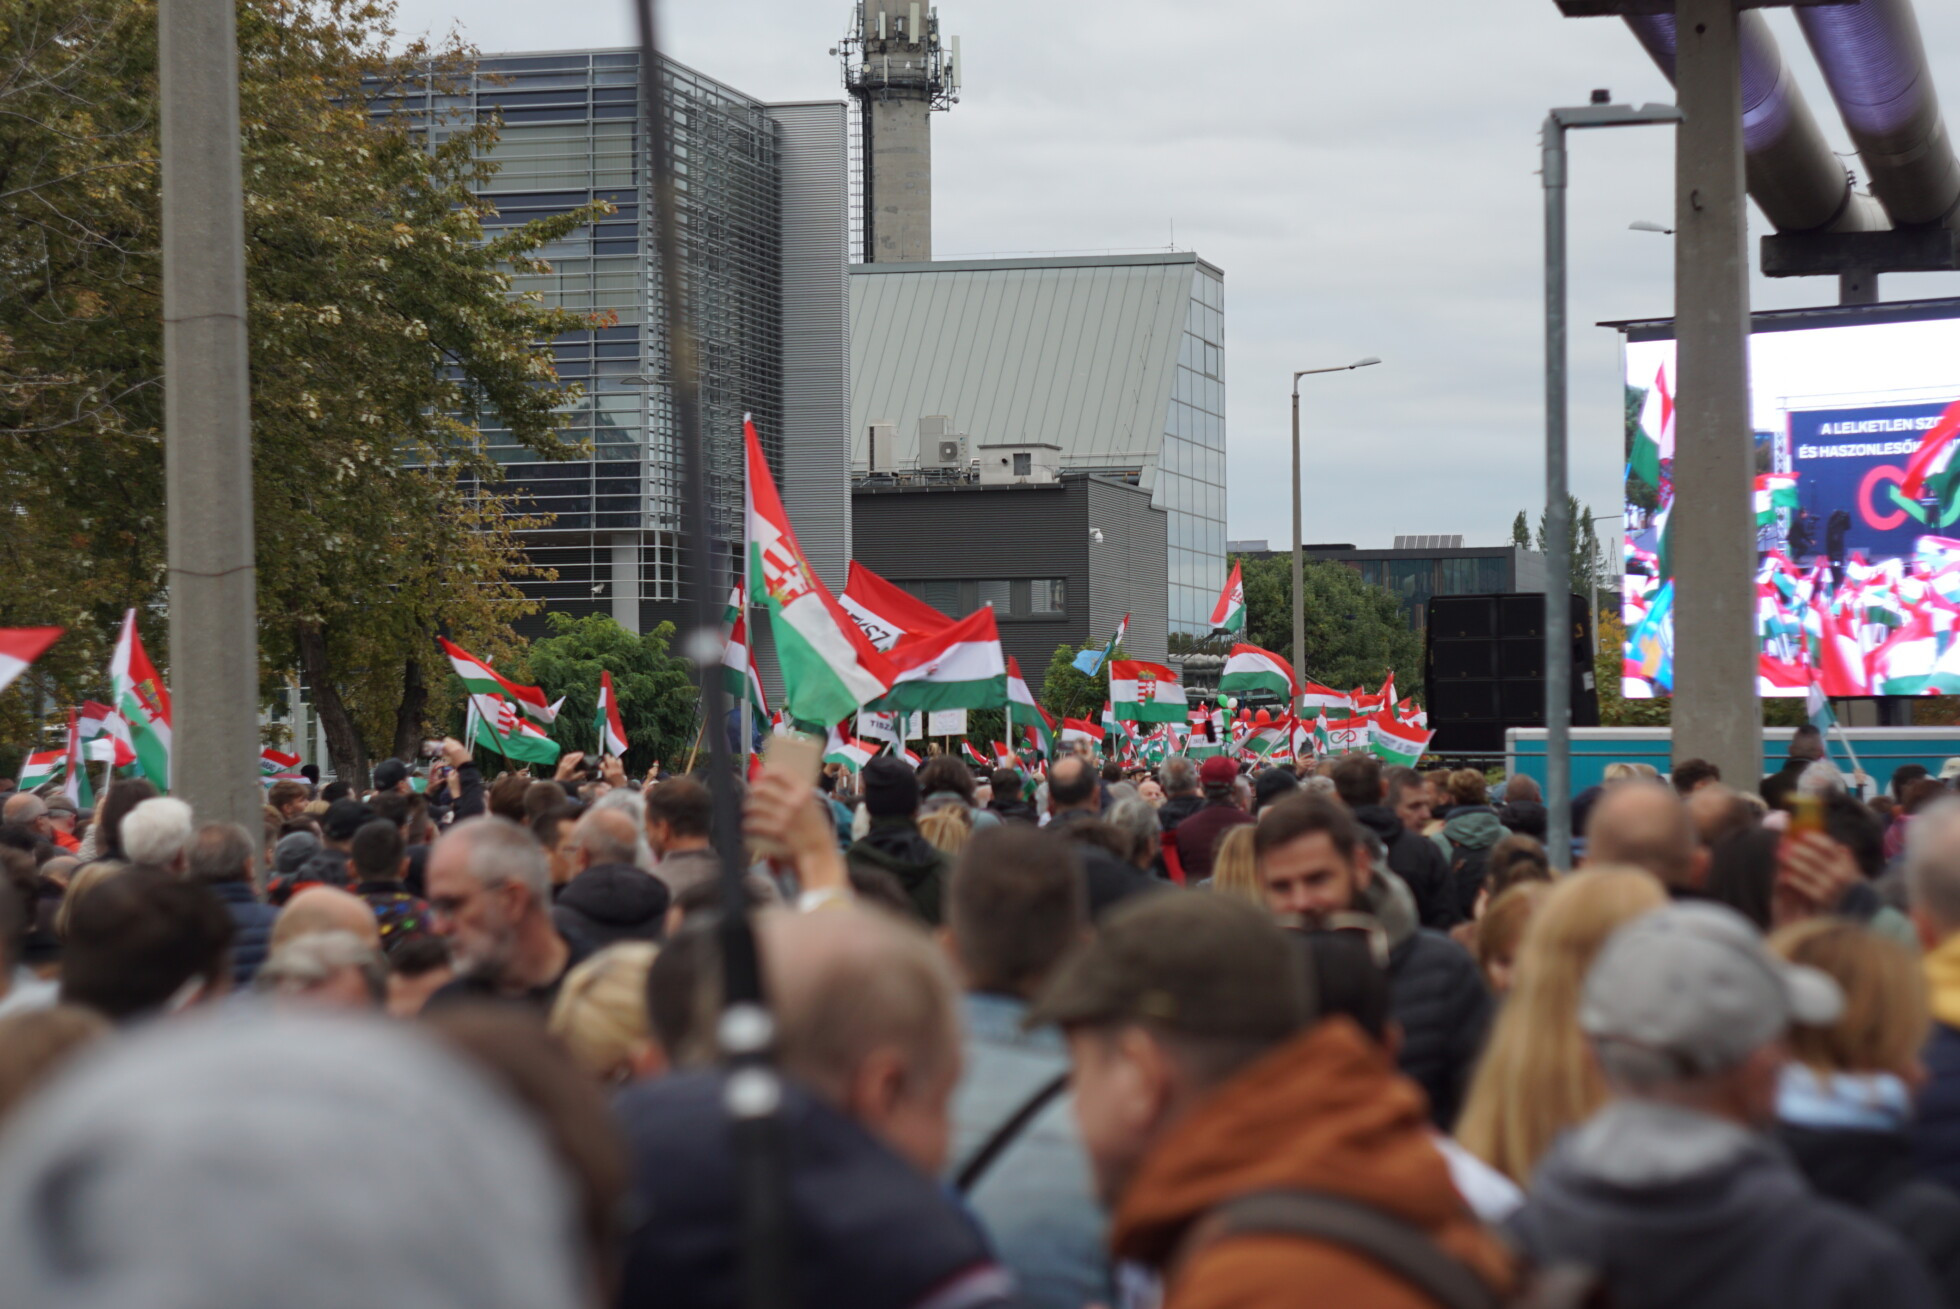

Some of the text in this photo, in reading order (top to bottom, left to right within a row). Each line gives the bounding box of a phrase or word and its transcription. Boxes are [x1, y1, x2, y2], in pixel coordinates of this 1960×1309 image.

[1821, 422, 1832, 435] A
[1833, 418, 1913, 434] LELKETLEN
[1798, 444, 1817, 458] ÉS
